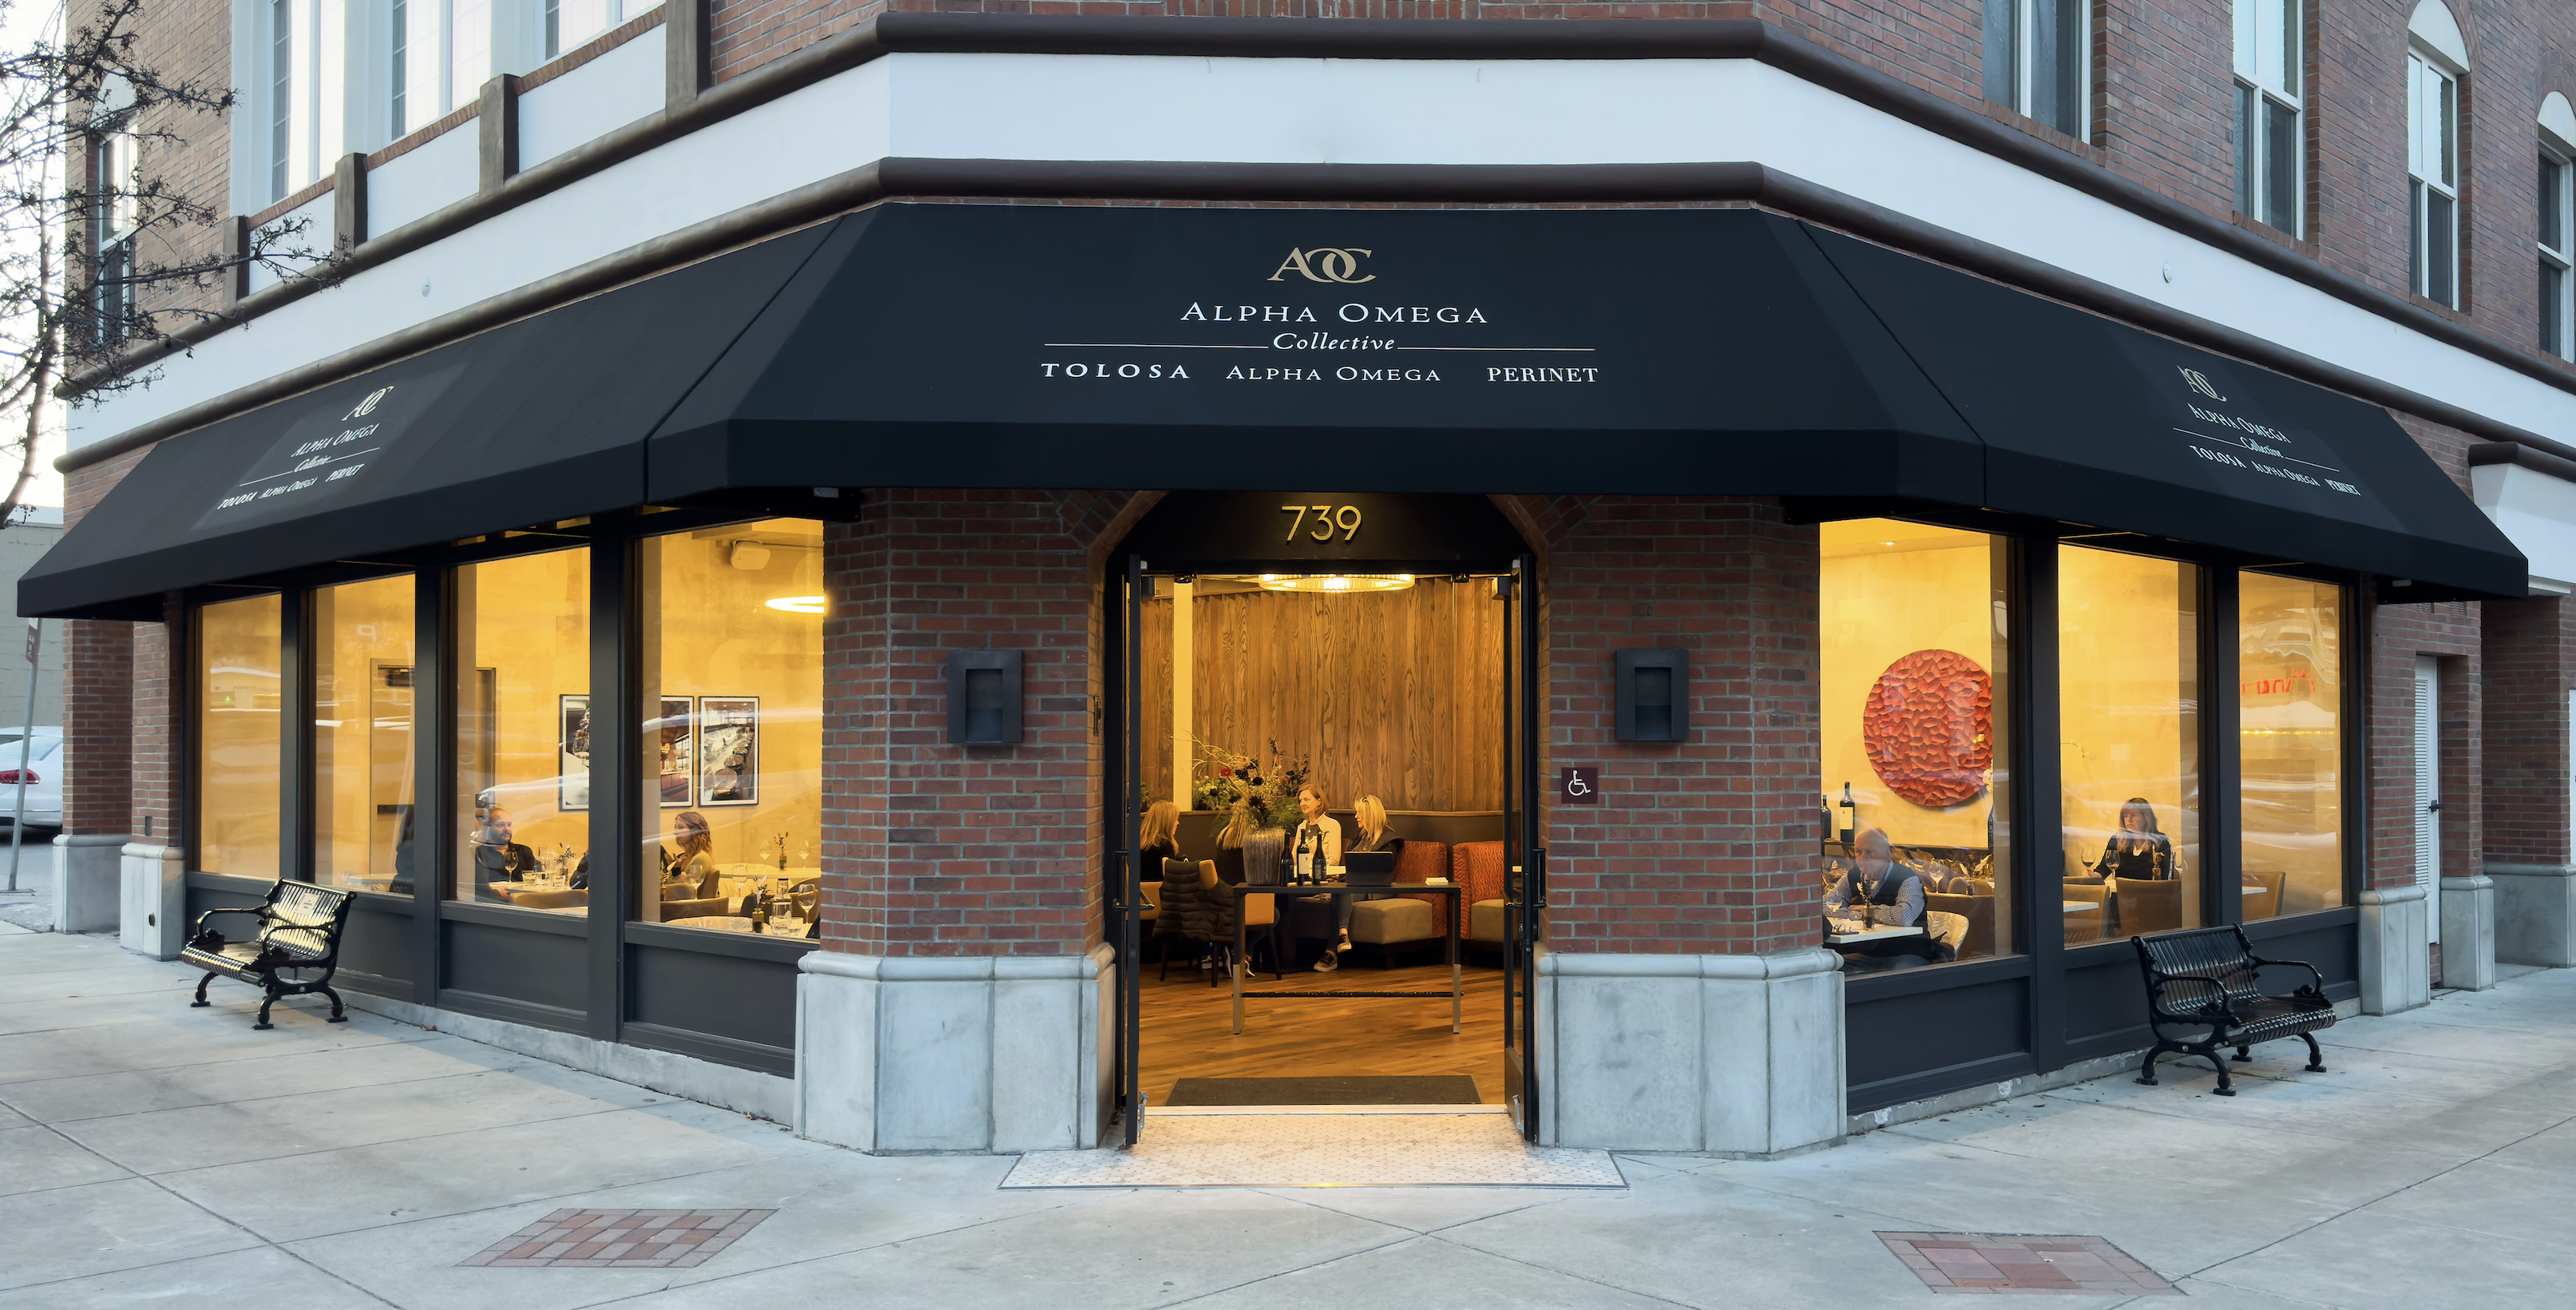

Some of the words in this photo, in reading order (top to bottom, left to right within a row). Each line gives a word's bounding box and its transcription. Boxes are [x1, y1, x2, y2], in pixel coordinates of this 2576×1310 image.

[1180, 302, 1318, 323] ALPHA
[1338, 303, 1488, 324] OMEGA
[1273, 331, 1395, 351] Collective
[1040, 363, 1191, 379] TOLOSA
[1225, 365, 1322, 381] ALPHA
[1336, 366, 1441, 382] OMEGA
[1486, 367, 1599, 383] PERINET
[2187, 403, 2241, 431] ALPHA
[2237, 417, 2292, 444] OMEGA
[290, 436, 335, 458] ALPHA
[332, 423, 380, 447] OMEGA
[2189, 445, 2248, 469] TOLOSA
[2250, 460, 2287, 478] ALPHA
[216, 490, 259, 510] TOLOSA
[1281, 505, 1362, 542] 739
